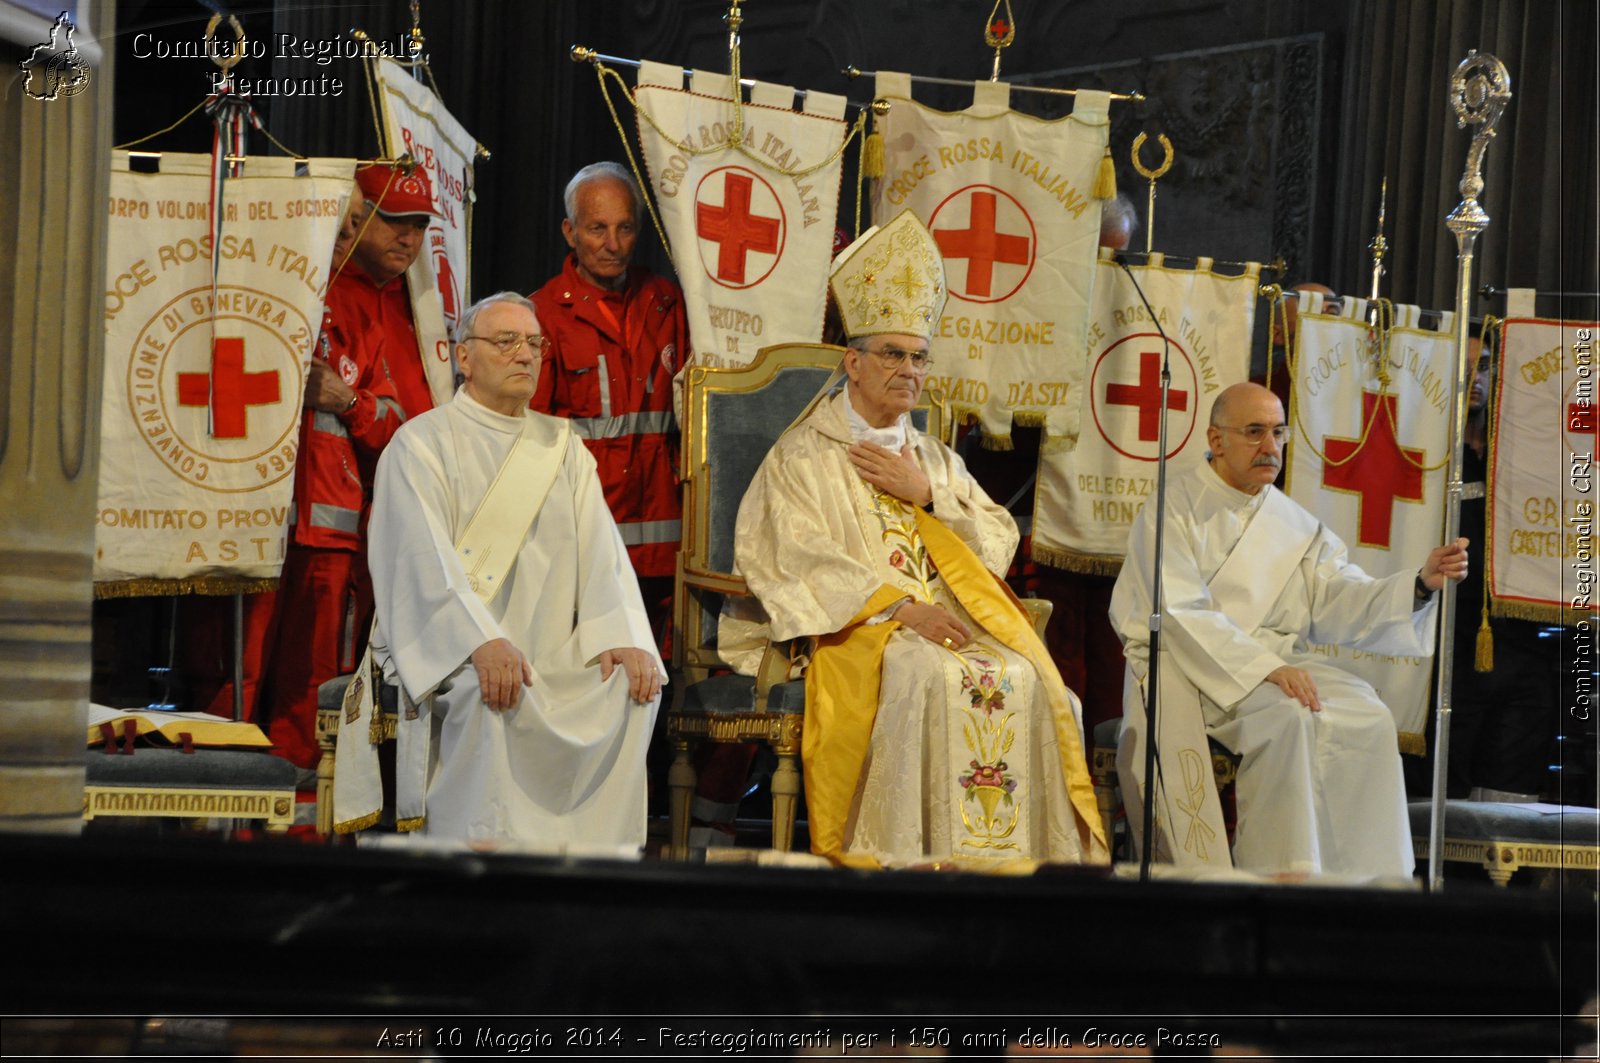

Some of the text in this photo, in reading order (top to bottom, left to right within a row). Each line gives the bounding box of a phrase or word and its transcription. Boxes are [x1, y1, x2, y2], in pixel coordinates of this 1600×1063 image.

[885, 137, 1089, 221] CROCE ROSSA ITALIANA
[248, 202, 278, 221] DEL
[162, 309, 184, 333] DI
[967, 344, 982, 360] DI
[1112, 303, 1168, 328] ROSSA
[1179, 316, 1219, 394] ITALIANA
[1006, 380, 1070, 407] D'ASTI
